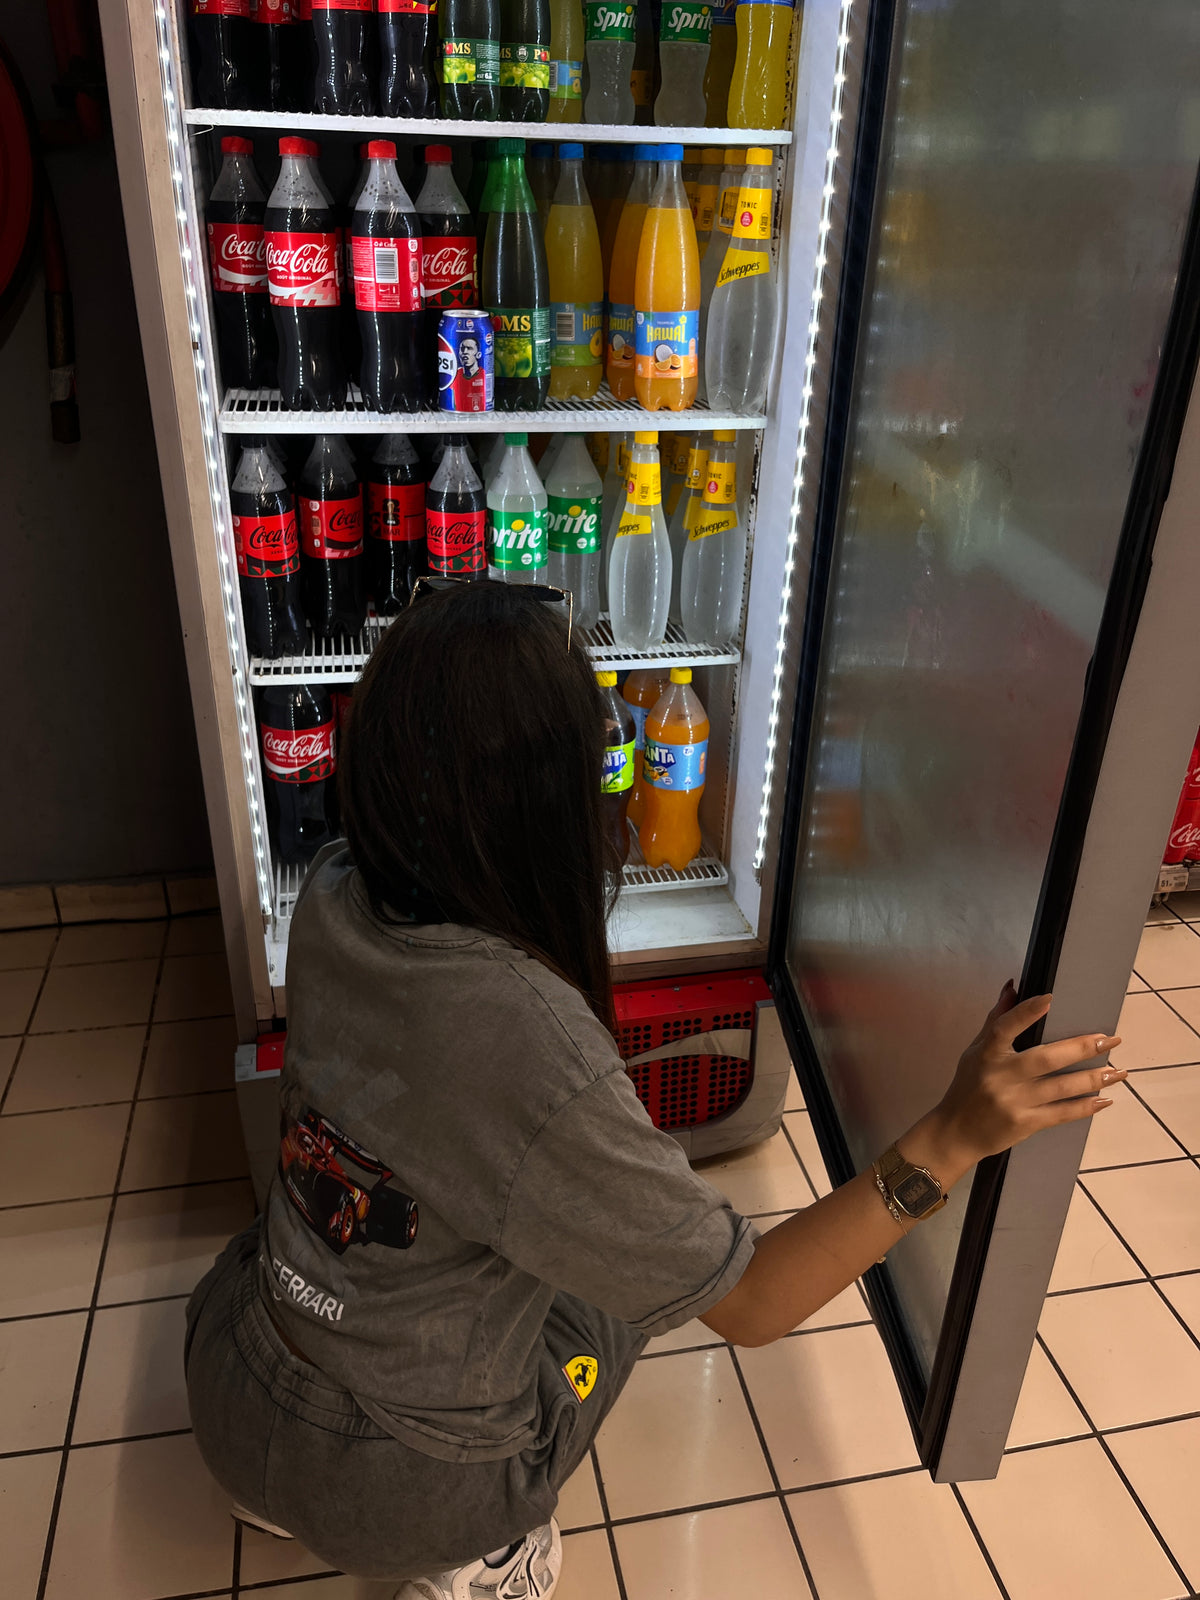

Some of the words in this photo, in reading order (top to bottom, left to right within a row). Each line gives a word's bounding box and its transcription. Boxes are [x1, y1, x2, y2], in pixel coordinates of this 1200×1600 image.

[266, 242, 329, 273] Coca-Cola
[720, 262, 760, 282] Schweppes
[692, 520, 730, 537] Schweppes
[264, 731, 326, 757] Coca-Cola
